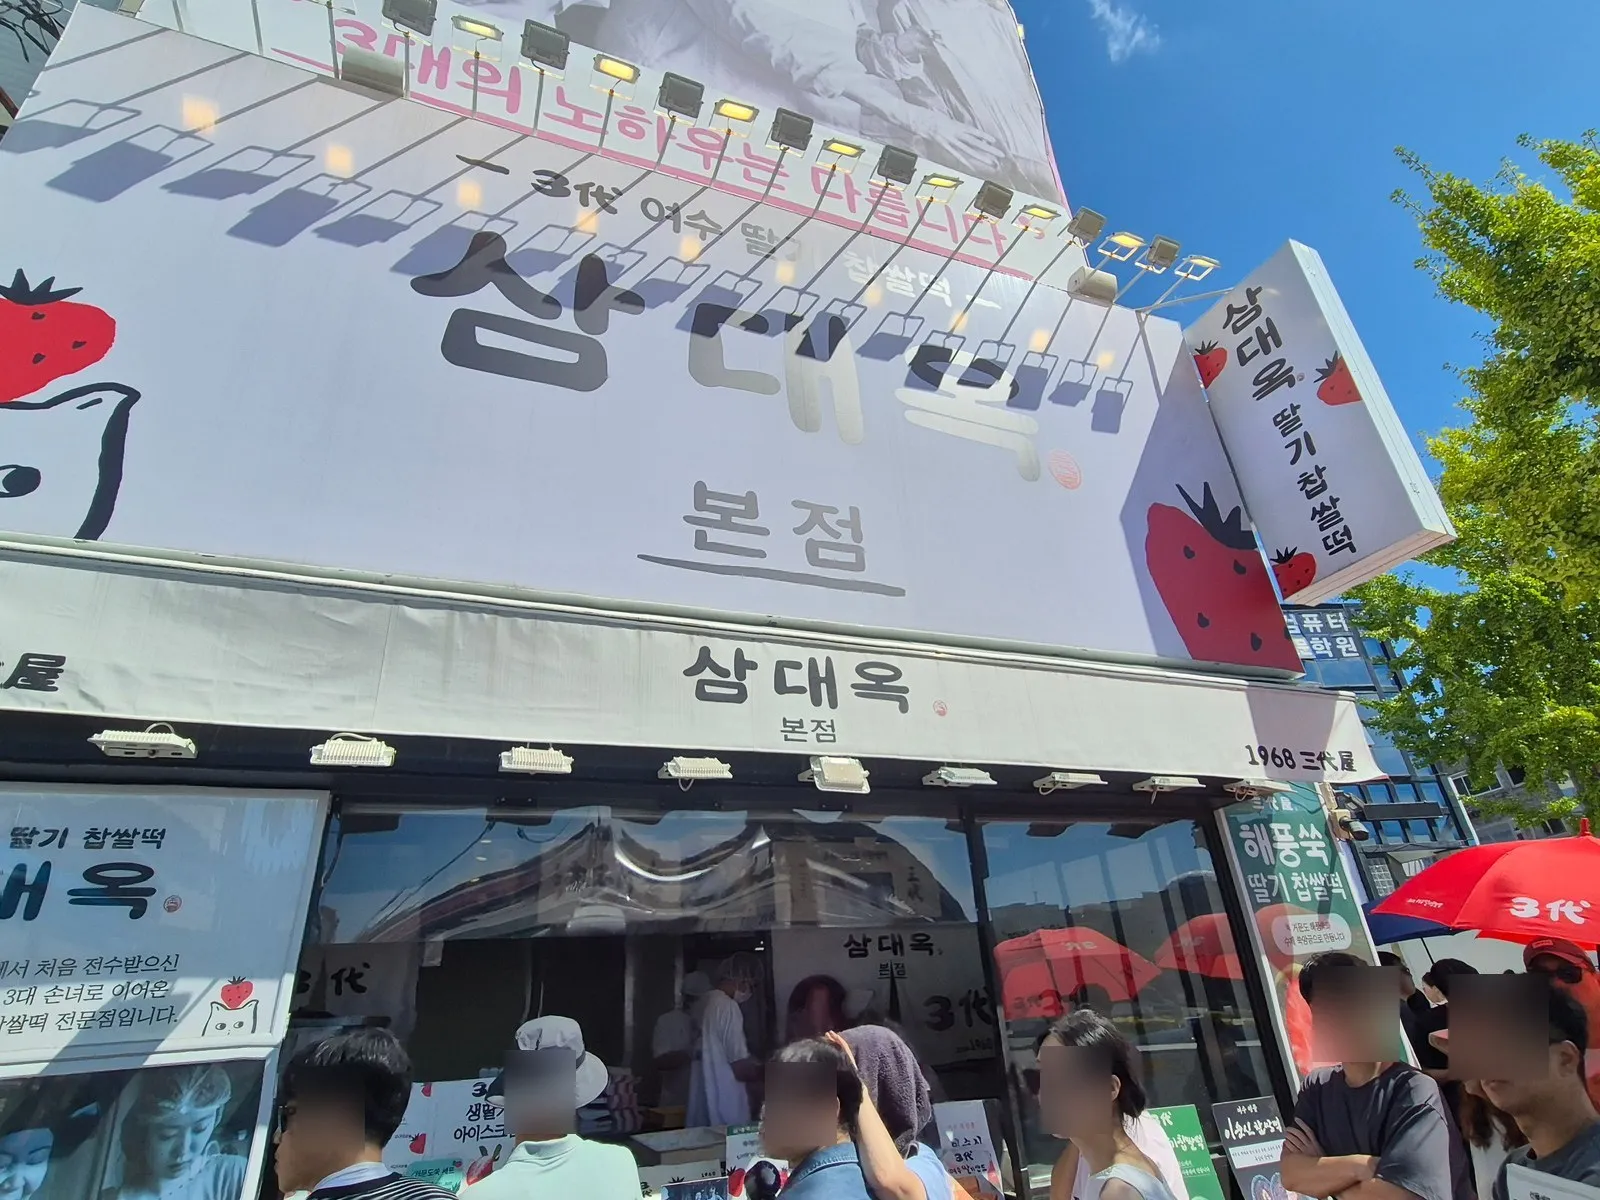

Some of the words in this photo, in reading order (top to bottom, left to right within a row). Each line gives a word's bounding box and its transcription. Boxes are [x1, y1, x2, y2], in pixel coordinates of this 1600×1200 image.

[543, 85, 790, 192] 노하우는
[531, 168, 624, 215] 3代
[640, 197, 723, 241] 여수
[410, 231, 1041, 483] 삼대옥
[1222, 286, 1297, 402] 삼대옥
[1272, 402, 1317, 466] 딸기
[1297, 464, 1358, 557] 찹쌀떡
[683, 480, 867, 573] 본점
[682, 645, 910, 715] 삼대옥
[780, 716, 837, 743] 본점
[1245, 744, 1297, 770] 1968
[1299, 750, 1358, 773] 三代屋
[9, 826, 70, 850] 딸기
[82, 825, 167, 850] 찹쌀떡
[1238, 822, 1330, 868] 해풍쑥
[1246, 871, 1292, 904] 딸기
[1290, 871, 1348, 903] 찹쌀떡
[1510, 896, 1592, 925] 3代
[843, 932, 935, 959] 삼대옥
[34, 957, 78, 979] 처음
[82, 953, 180, 977] 전수받으신
[878, 961, 907, 979] 본점
[3, 985, 38, 1006] 3대
[43, 983, 105, 1004] 손녀로
[111, 979, 169, 1002] 이어온
[54, 1004, 179, 1032] 전문점입니다.
[454, 1124, 515, 1143] 아이스크
